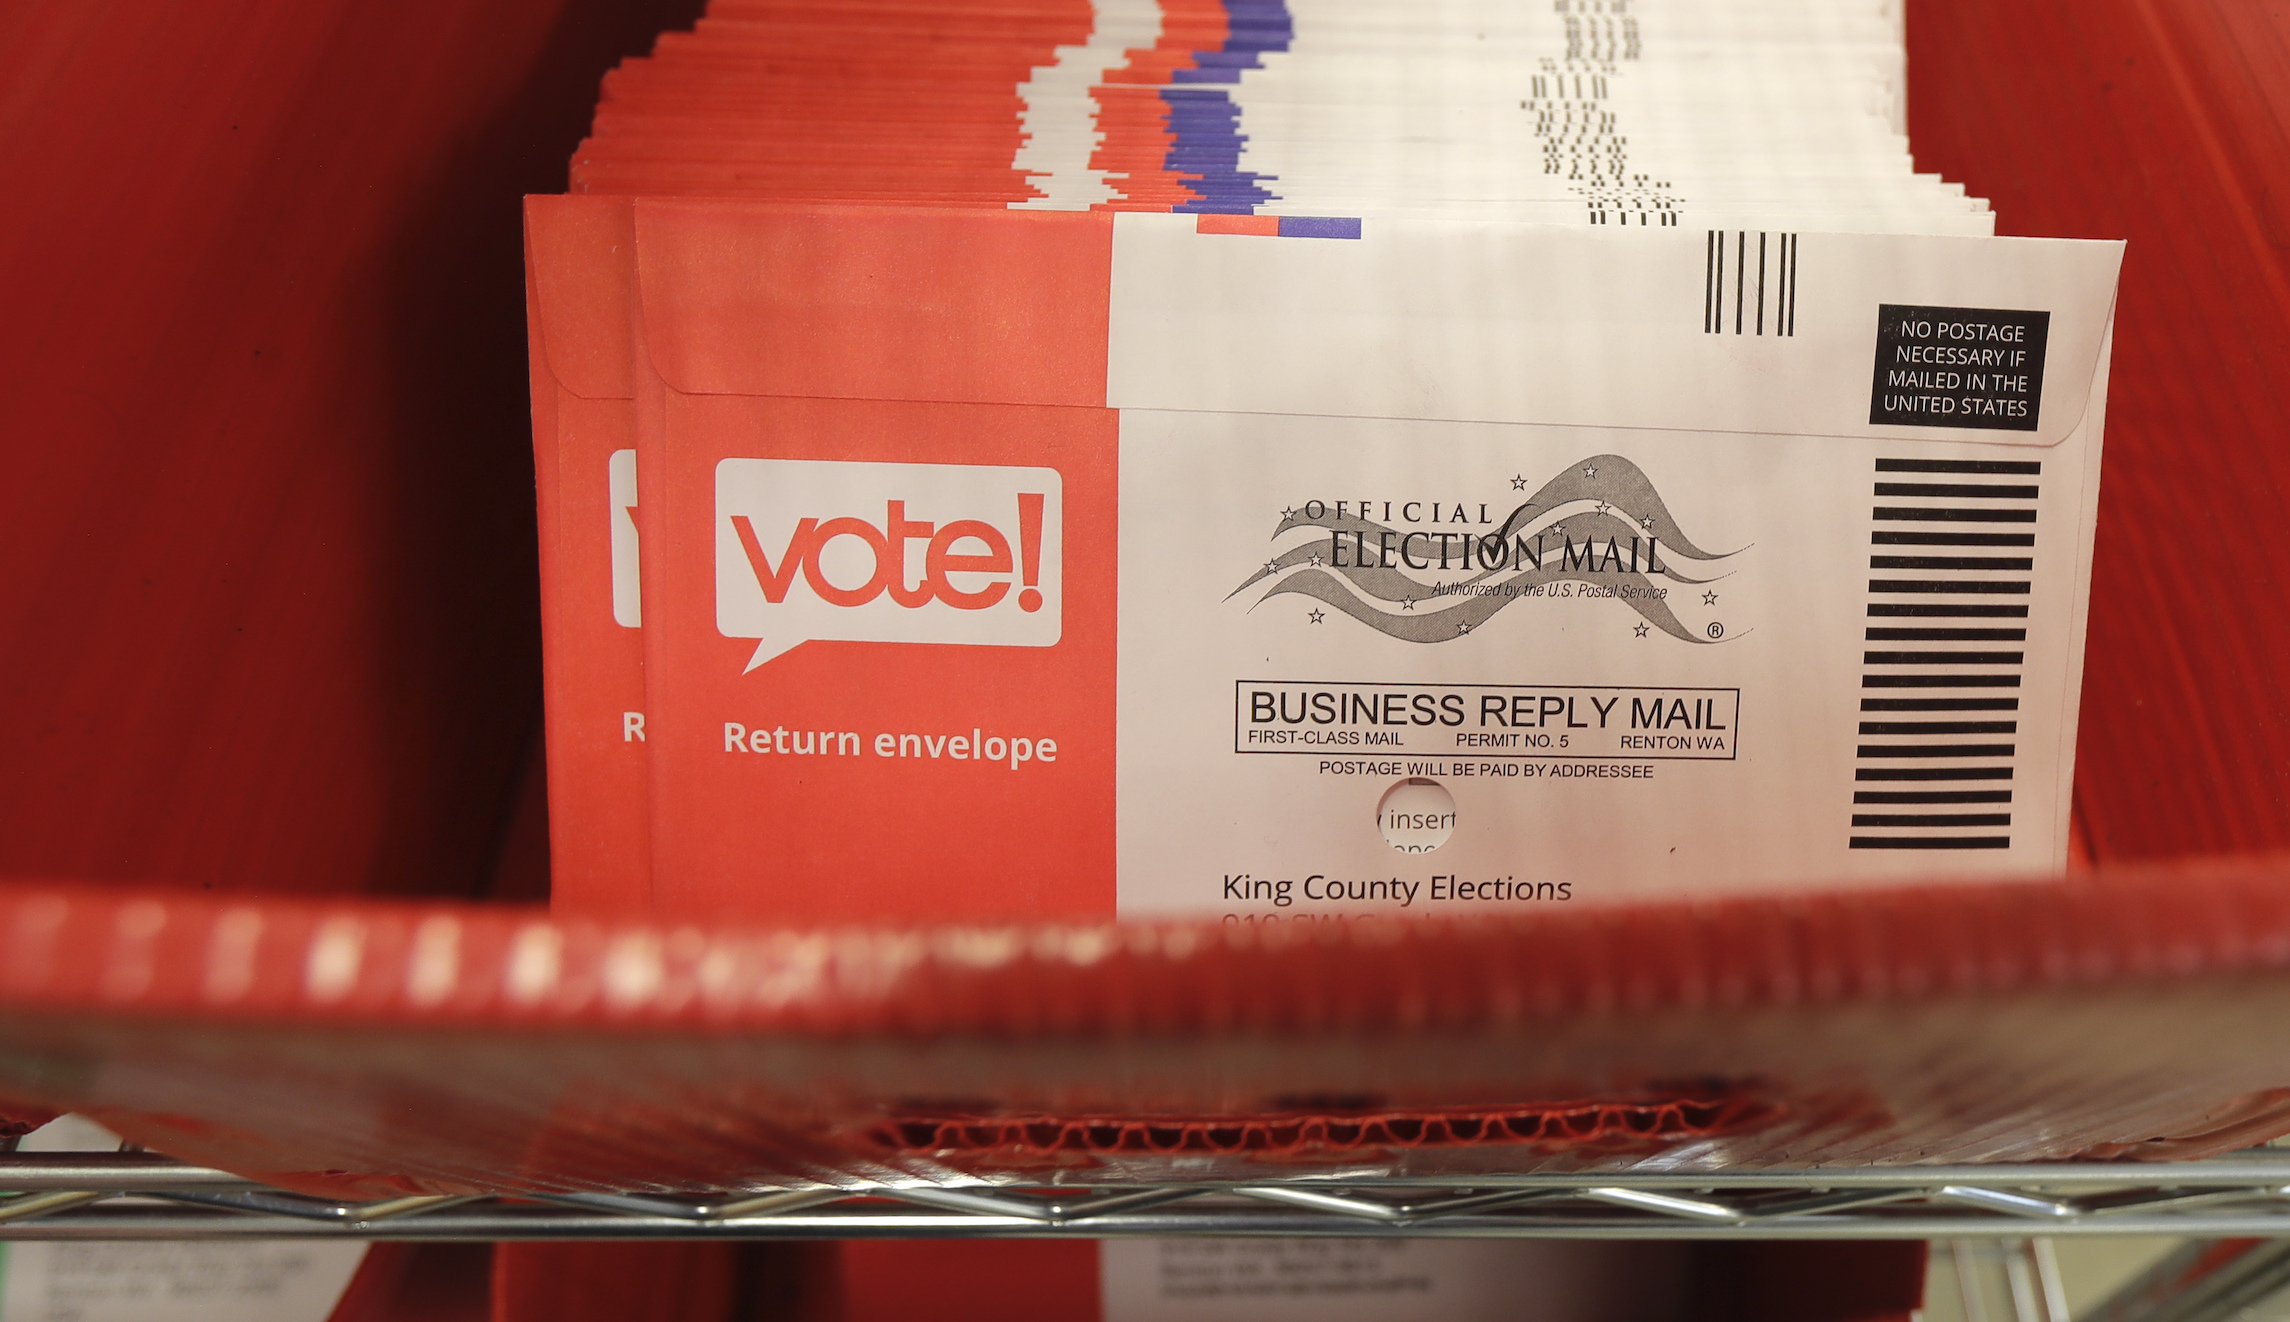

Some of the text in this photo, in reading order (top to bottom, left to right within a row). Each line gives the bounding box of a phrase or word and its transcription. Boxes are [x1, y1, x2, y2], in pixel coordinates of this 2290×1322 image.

[1901, 320, 2025, 343] NO POSTAGE
[1896, 345, 2026, 367] NECESSARY IF
[1888, 370, 2028, 393] MAILED IN THE
[1884, 394, 2028, 417] UNITED STATES
[1305, 500, 1492, 524] OFFICIAL
[730, 493, 1044, 612] vote!
[1329, 528, 1666, 574] ELECTION MAIL
[1431, 581, 1668, 600] Authorized by the U.S. Postal Service
[1250, 691, 1727, 731] BUSINESS REPLY MAIL
[724, 721, 1058, 770] Return envelope
[1248, 729, 1725, 751] FIRST-CLASS MAIL PERMIT NO. 5 RENTON WA
[1319, 761, 1654, 779] POSTAGE WILL BE PAID BY ADDRESSEE
[1223, 874, 1573, 907] King County Elections
